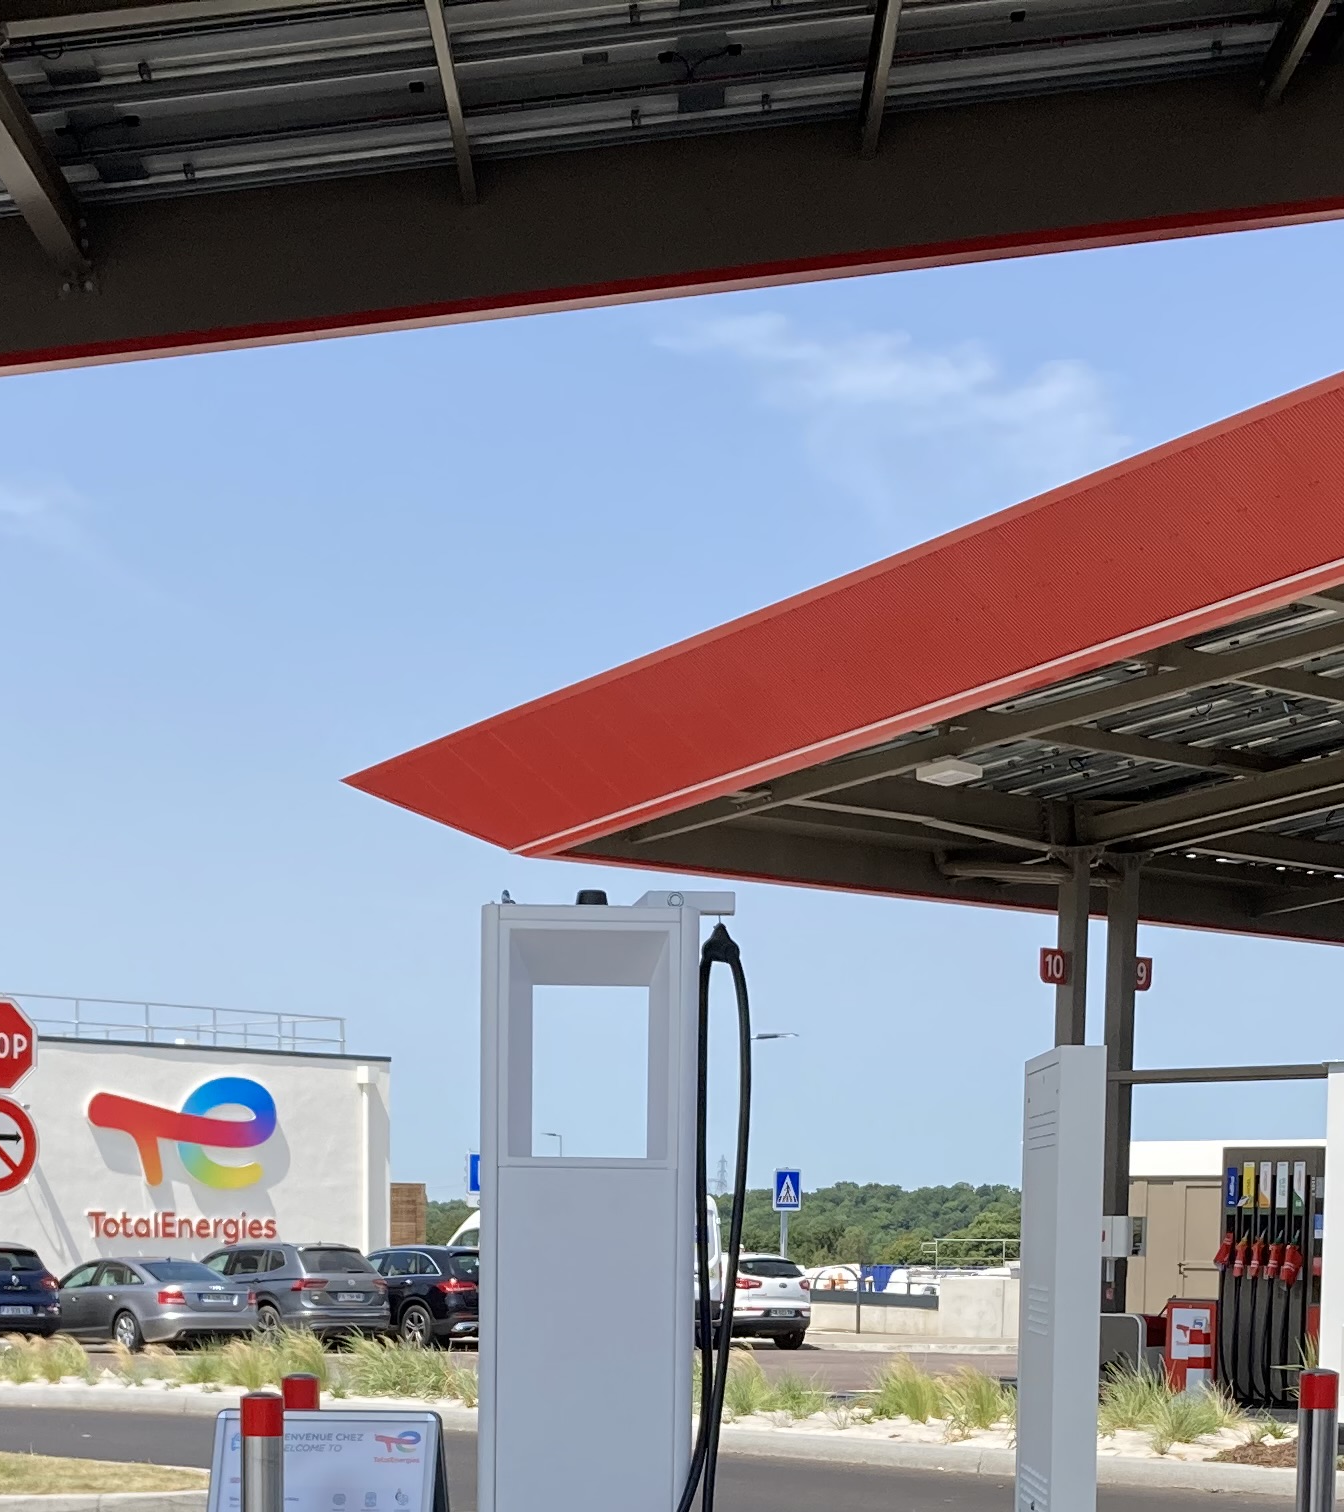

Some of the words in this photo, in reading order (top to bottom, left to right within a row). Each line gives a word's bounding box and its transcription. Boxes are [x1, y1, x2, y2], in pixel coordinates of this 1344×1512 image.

[1045, 954, 1064, 979] 10
[1136, 962, 1147, 985] 9
[87, 1210, 278, 1244] TotalEnergies
[283, 1444, 326, 1453] ELCOME
[328, 1444, 343, 1453] TO
[285, 1433, 334, 1442] ENVENUE
[336, 1433, 364, 1442] CHEZ
